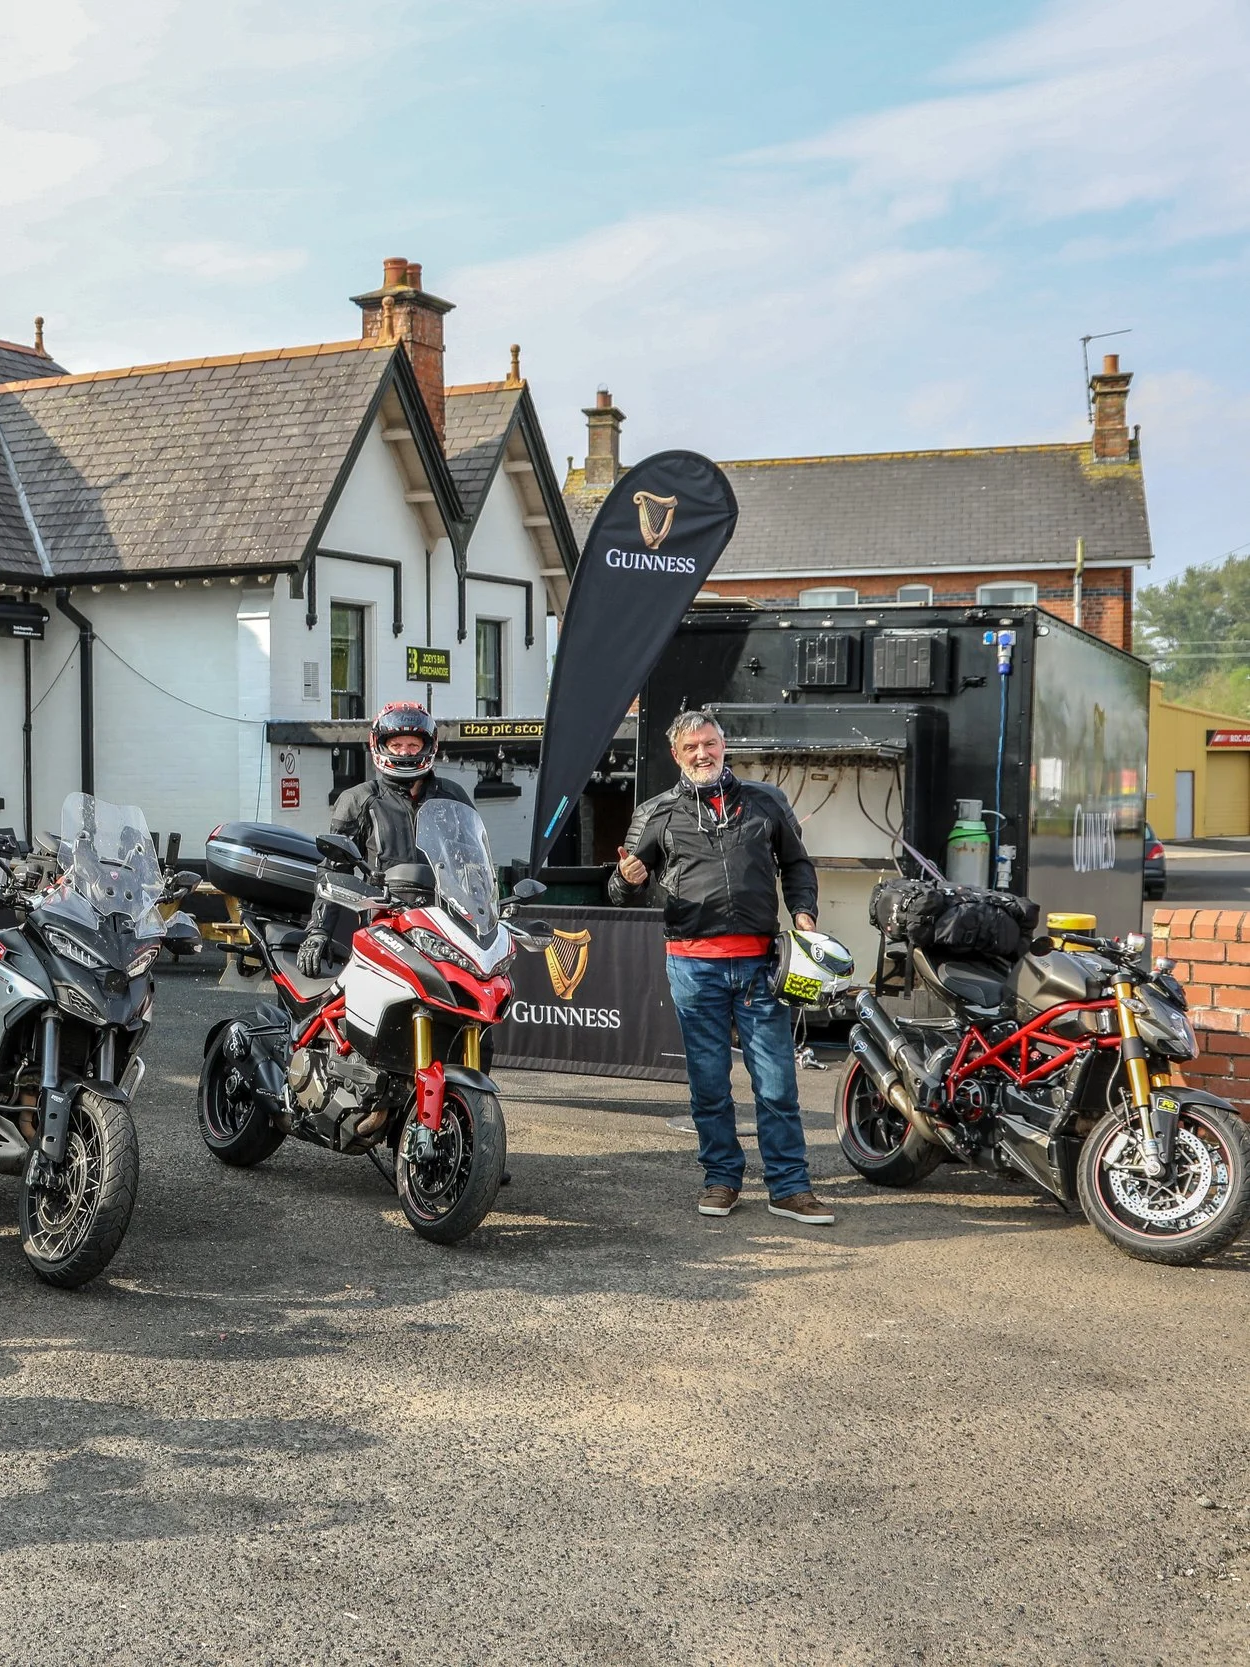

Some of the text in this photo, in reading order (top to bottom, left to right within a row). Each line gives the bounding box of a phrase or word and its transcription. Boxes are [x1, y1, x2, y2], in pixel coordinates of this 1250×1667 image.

[605, 548, 696, 574] GUINNESS
[419, 665, 449, 677] MERCHANDISE
[464, 724, 489, 735] the
[492, 723, 512, 736] pit
[282, 780, 299, 789] Smoking
[285, 789, 296, 797] Area
[374, 930, 405, 953] DUCATI
[511, 1000, 621, 1029] GUINNESS
